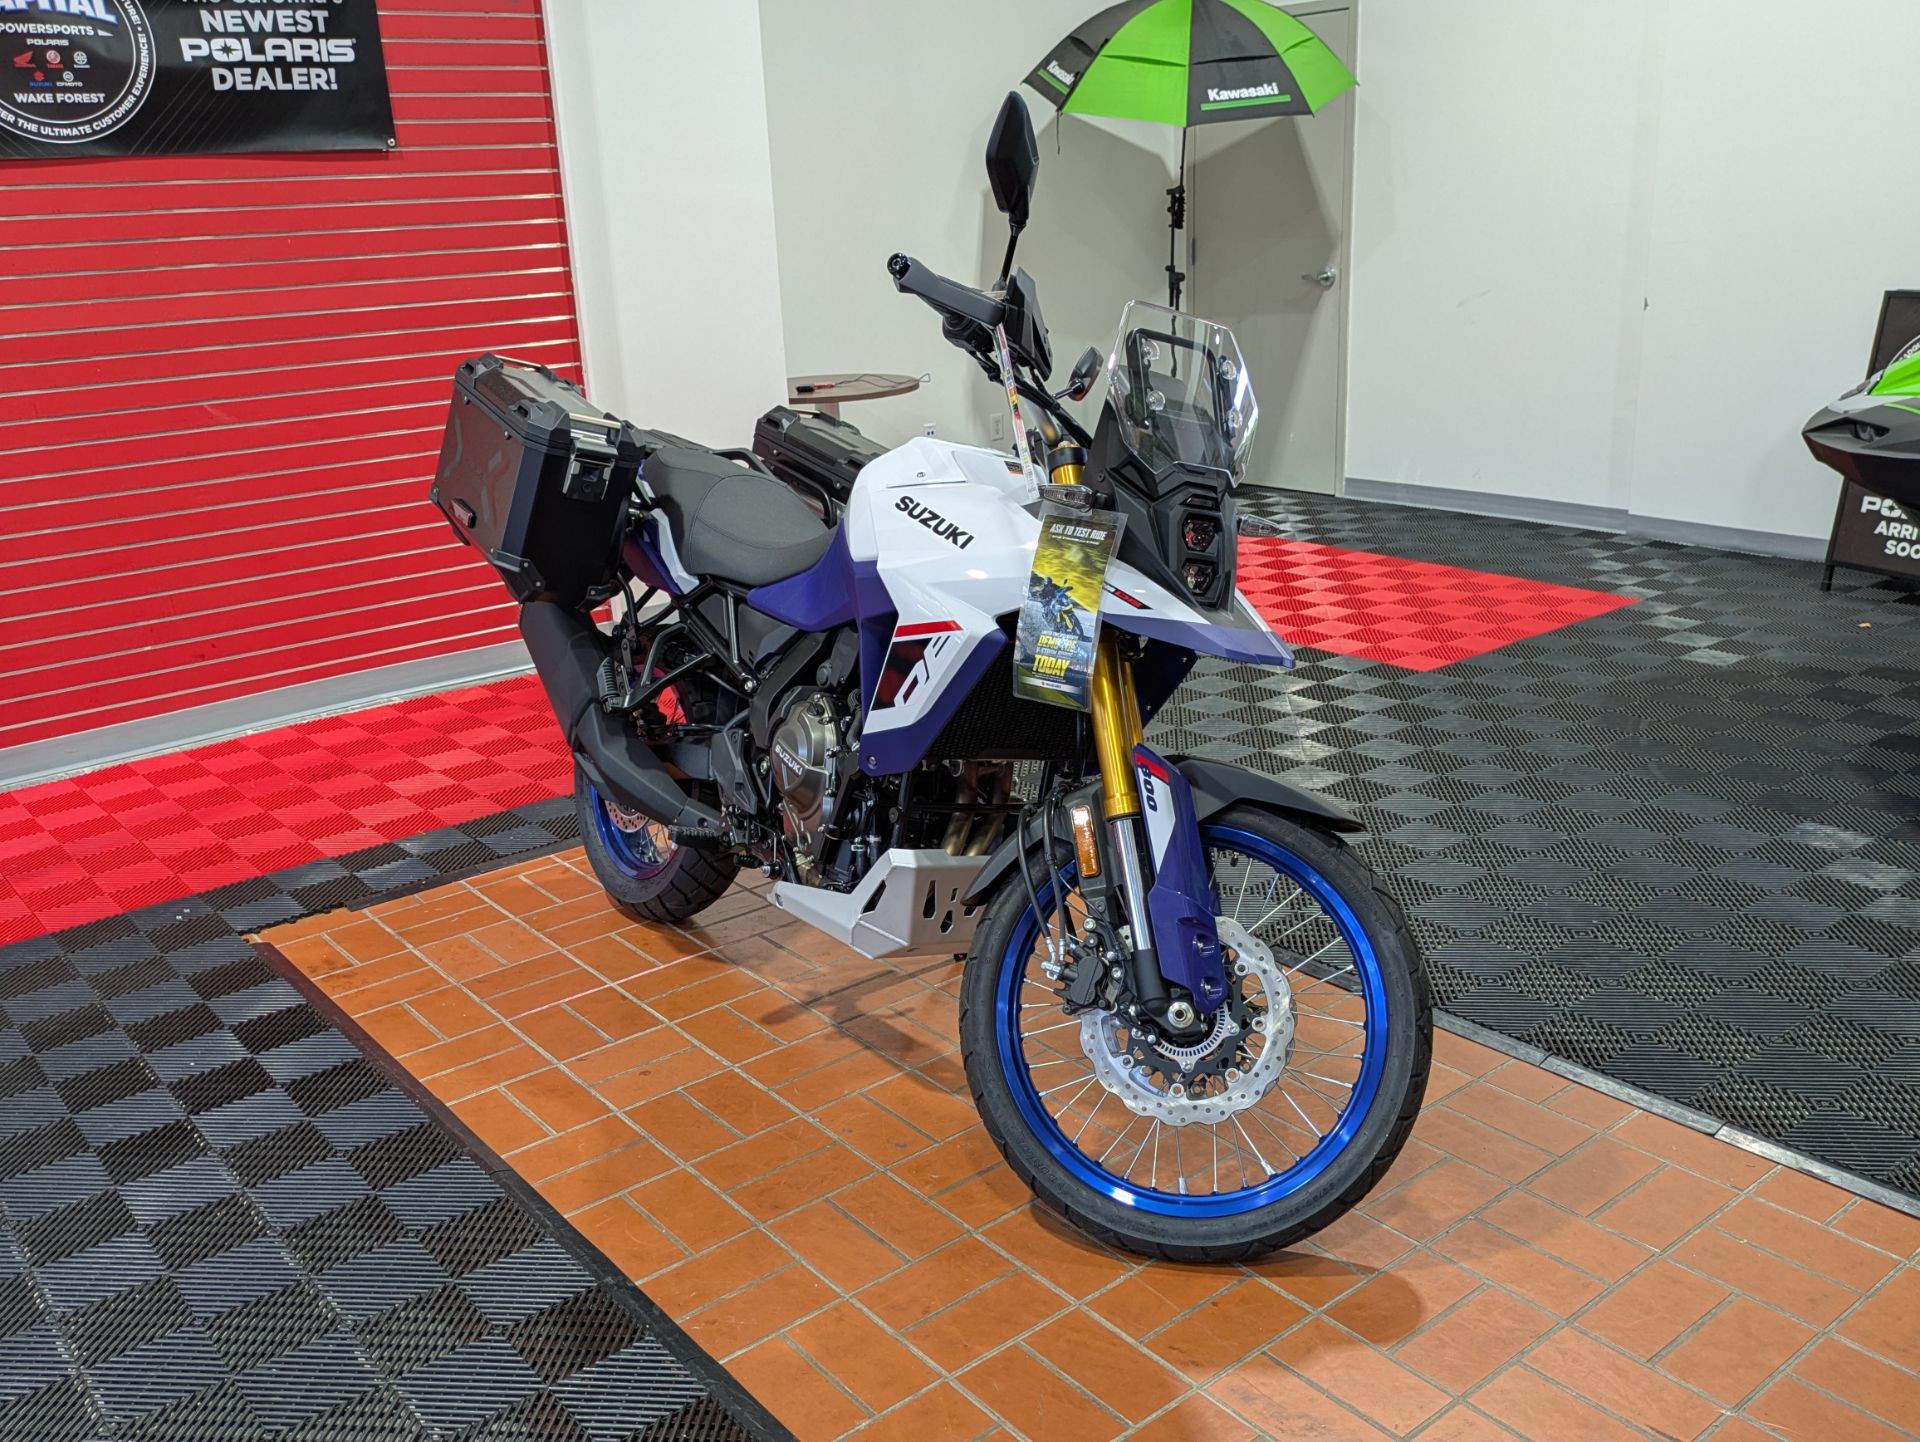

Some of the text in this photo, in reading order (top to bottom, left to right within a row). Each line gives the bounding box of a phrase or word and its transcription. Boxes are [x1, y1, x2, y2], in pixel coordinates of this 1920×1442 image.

[0, 23, 94, 35] POWERSPORTS
[200, 10, 328, 33] NEWEST
[26, 38, 69, 46] POLARIS
[179, 38, 356, 62] POLARIS
[17, 118, 39, 132] THE
[40, 125, 92, 137] ULTIMATE
[92, 95, 137, 131] CUSTOMER
[132, 33, 149, 97] EXPERIENCE!
[211, 67, 338, 91] DEALER!
[14, 93, 105, 103] WAKE FOREST
[1207, 82, 1279, 101] Kawasaki
[895, 495, 975, 550] SUZUKI
[1049, 523, 1066, 534] ASK
[1064, 525, 1075, 535] TO
[1074, 526, 1091, 538] TEST
[1090, 529, 1108, 541] RIDE
[1032, 654, 1071, 677] TODAY
[775, 744, 803, 776] SUZUKI
[1141, 763, 1158, 813] 800
